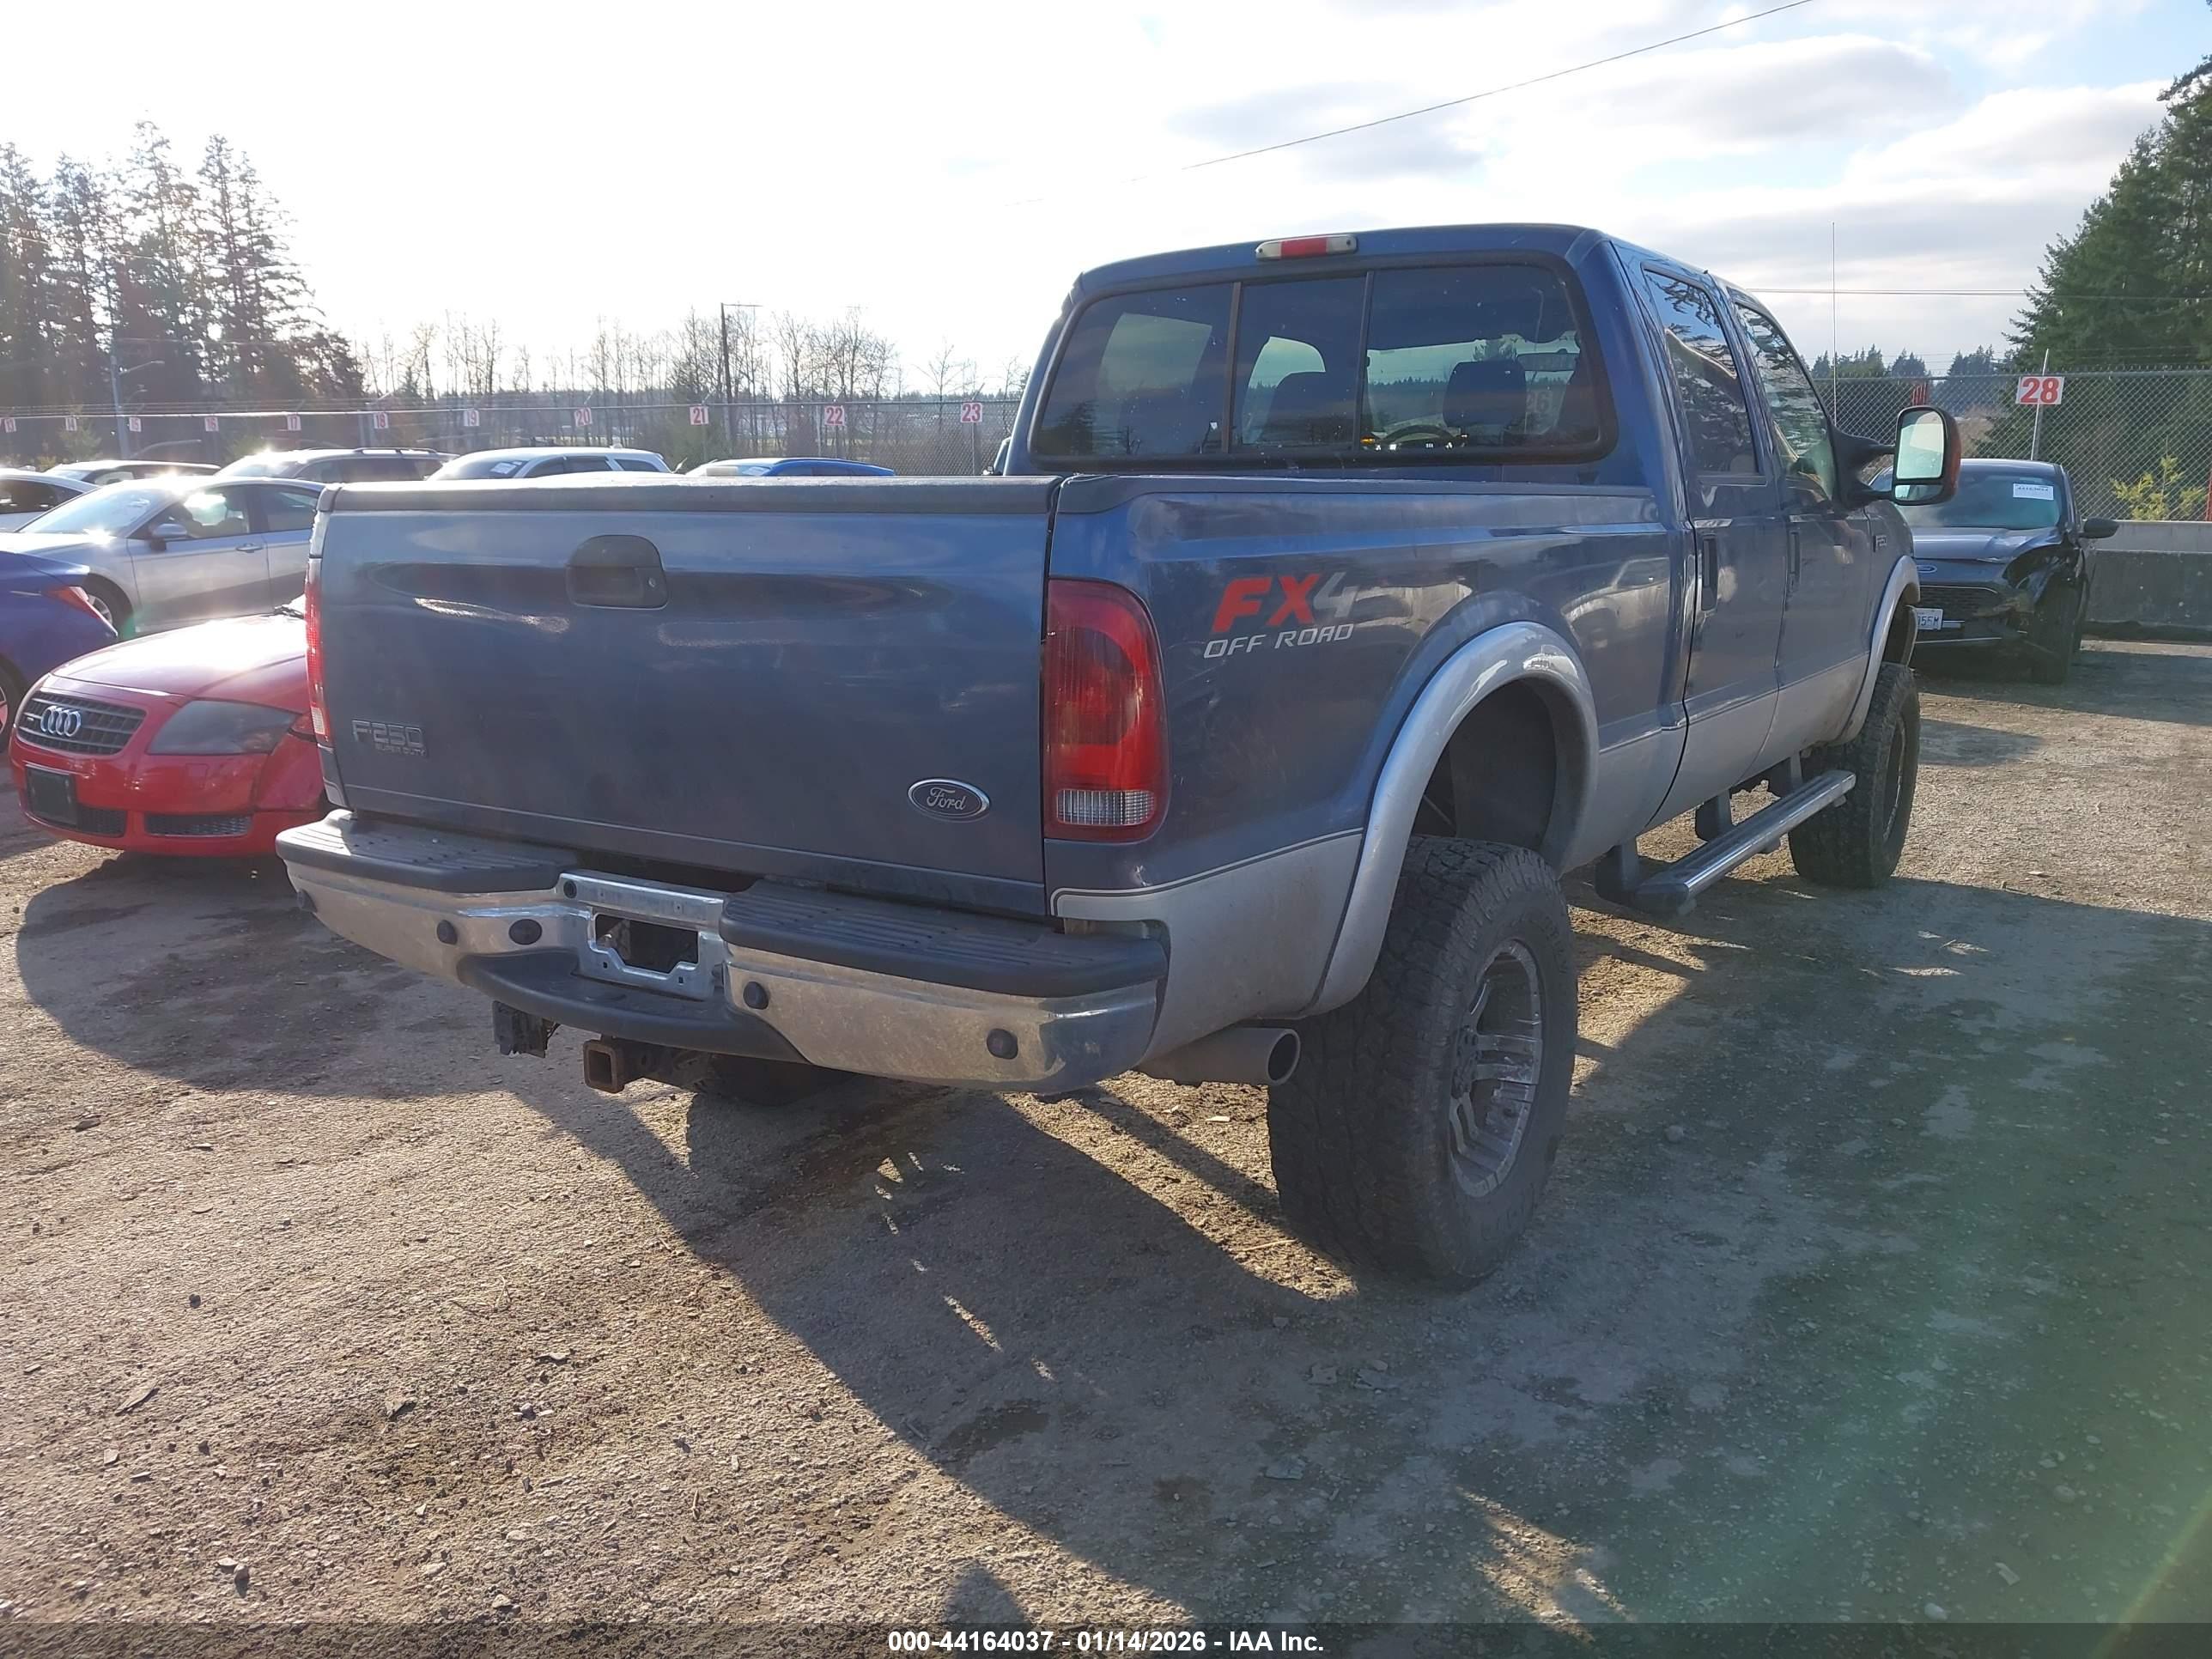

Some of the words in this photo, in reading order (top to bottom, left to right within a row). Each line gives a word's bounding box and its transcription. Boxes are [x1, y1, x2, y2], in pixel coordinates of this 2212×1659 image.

[2019, 377, 2061, 404] 28
[375, 412, 386, 428] 18
[575, 409, 591, 426] 20
[692, 408, 708, 425] 21
[825, 407, 844, 425] 22
[961, 403, 981, 423] 23
[1212, 571, 1358, 634] FX4
[1204, 634, 1266, 659] OFF
[1274, 623, 1355, 647] ROAD
[926, 786, 968, 811] Ford
